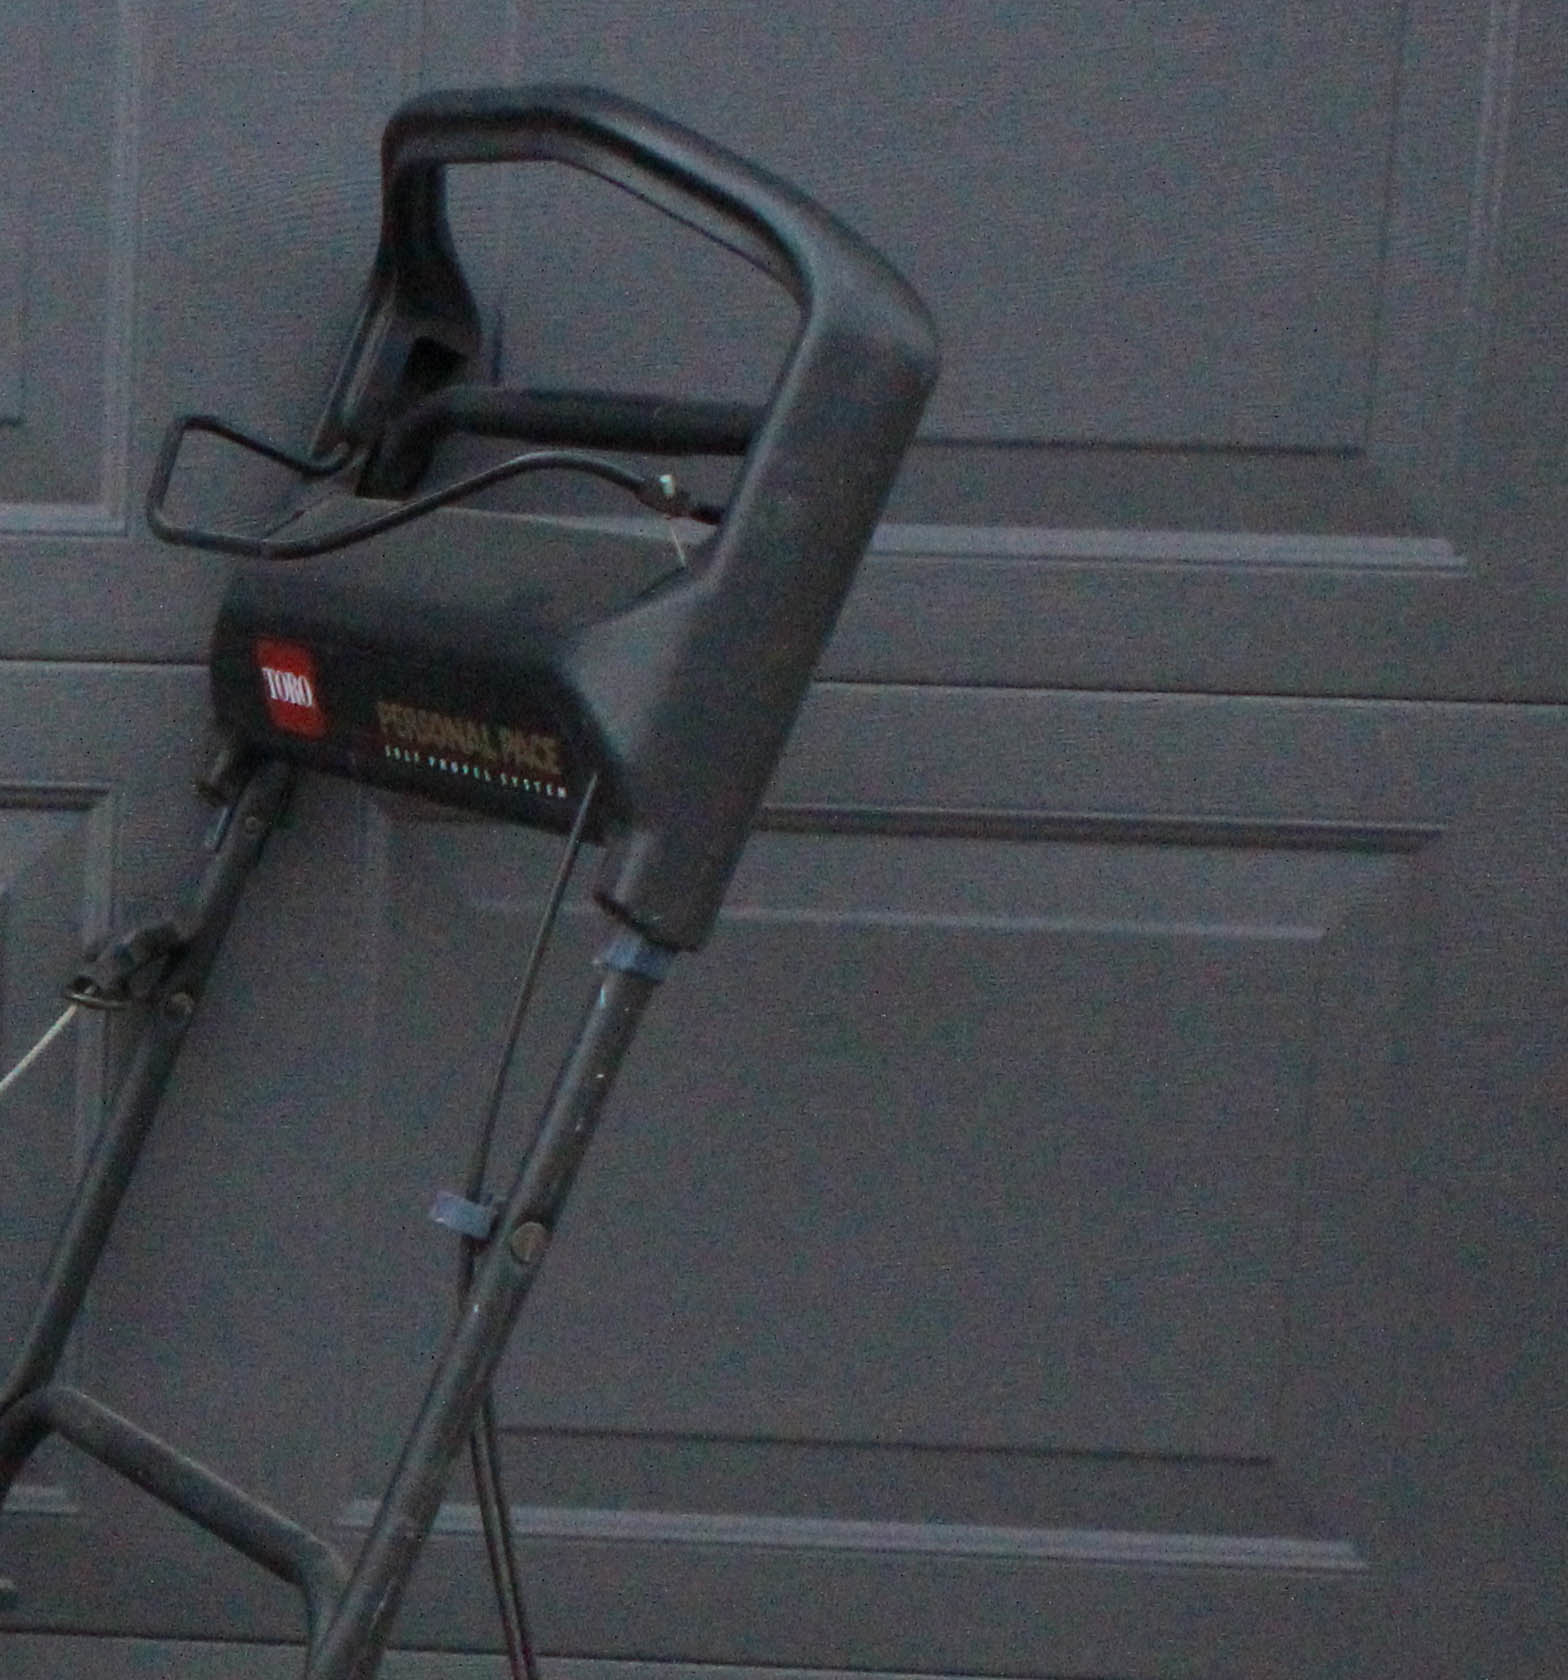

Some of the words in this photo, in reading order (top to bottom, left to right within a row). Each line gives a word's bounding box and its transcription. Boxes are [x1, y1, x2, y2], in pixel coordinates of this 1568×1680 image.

[262, 666, 313, 708] TORO
[499, 726, 562, 775] PACE
[500, 772, 567, 799] SYSTEM
